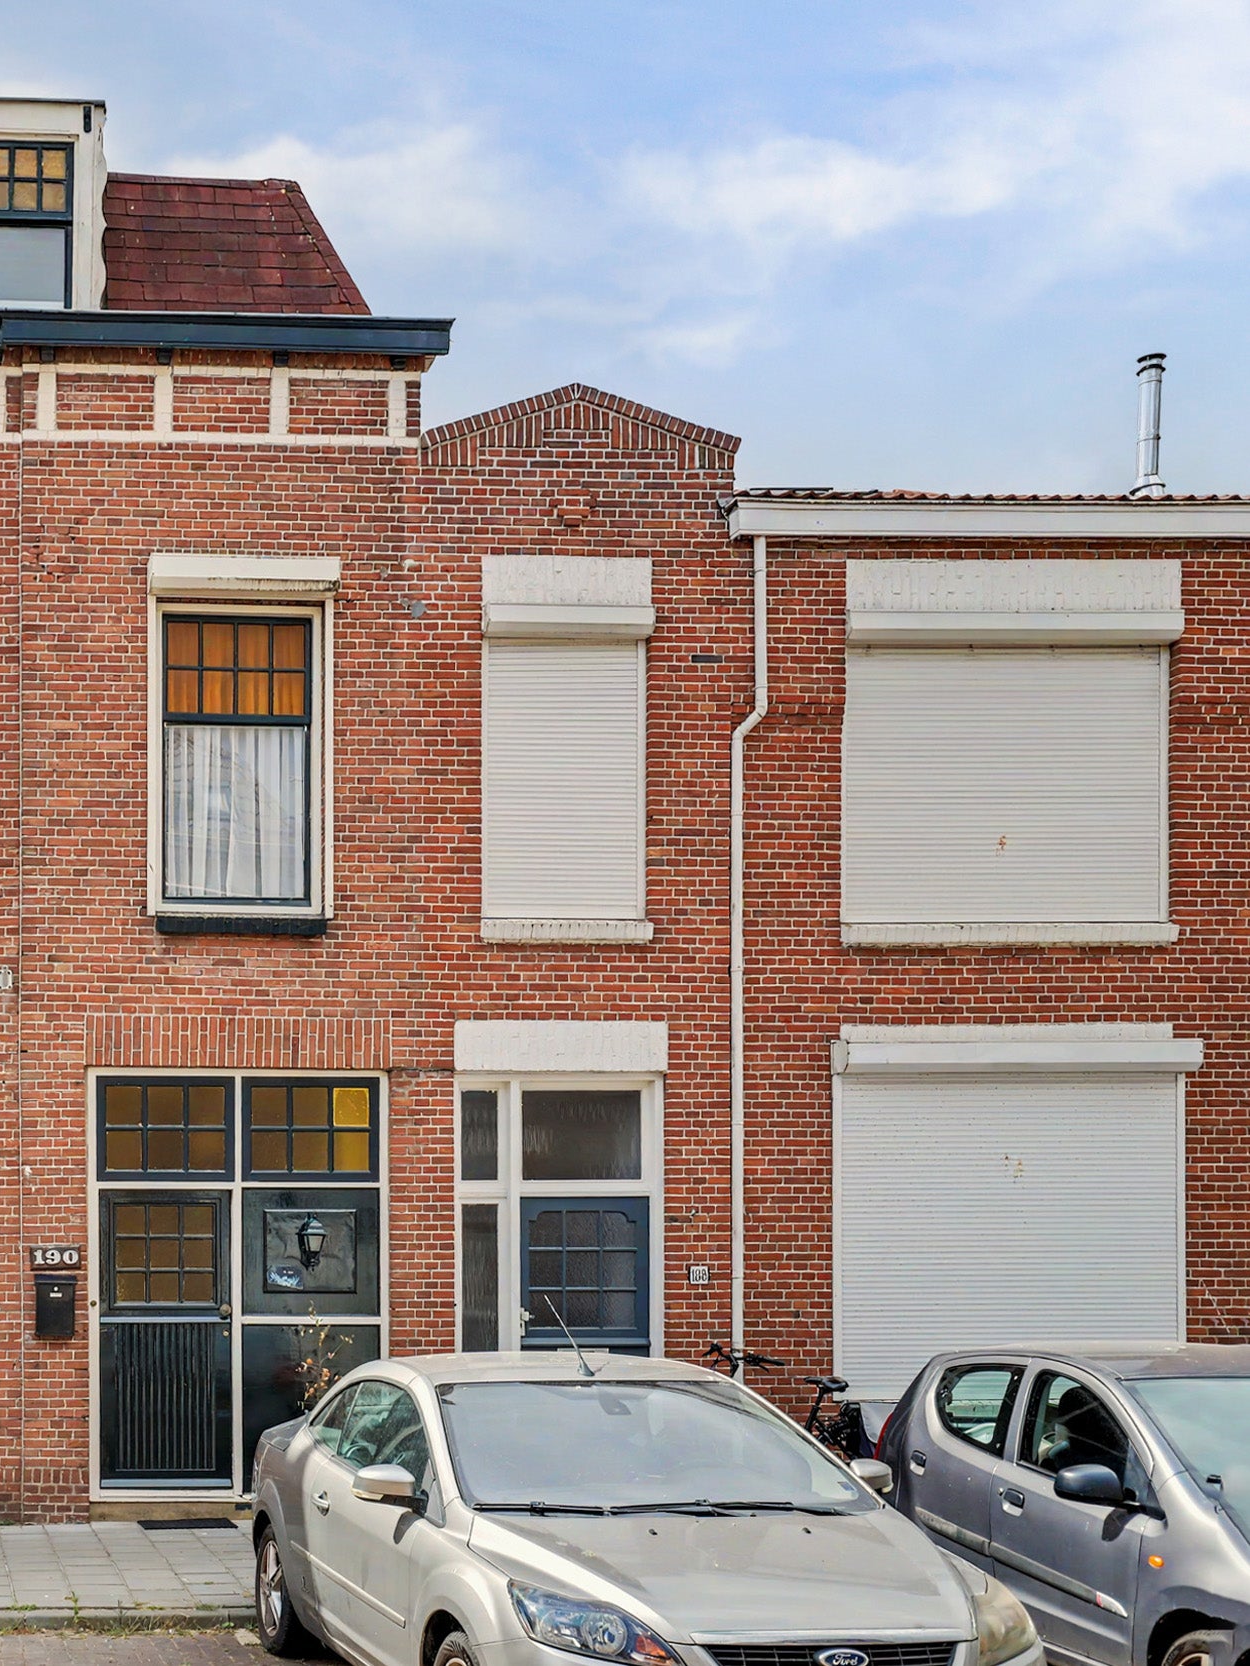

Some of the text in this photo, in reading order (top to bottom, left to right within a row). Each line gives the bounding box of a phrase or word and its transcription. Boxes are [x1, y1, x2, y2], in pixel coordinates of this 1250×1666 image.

[33, 1249, 79, 1265] 190
[691, 1268, 708, 1282] 188
[833, 1653, 858, 1666] Ford
